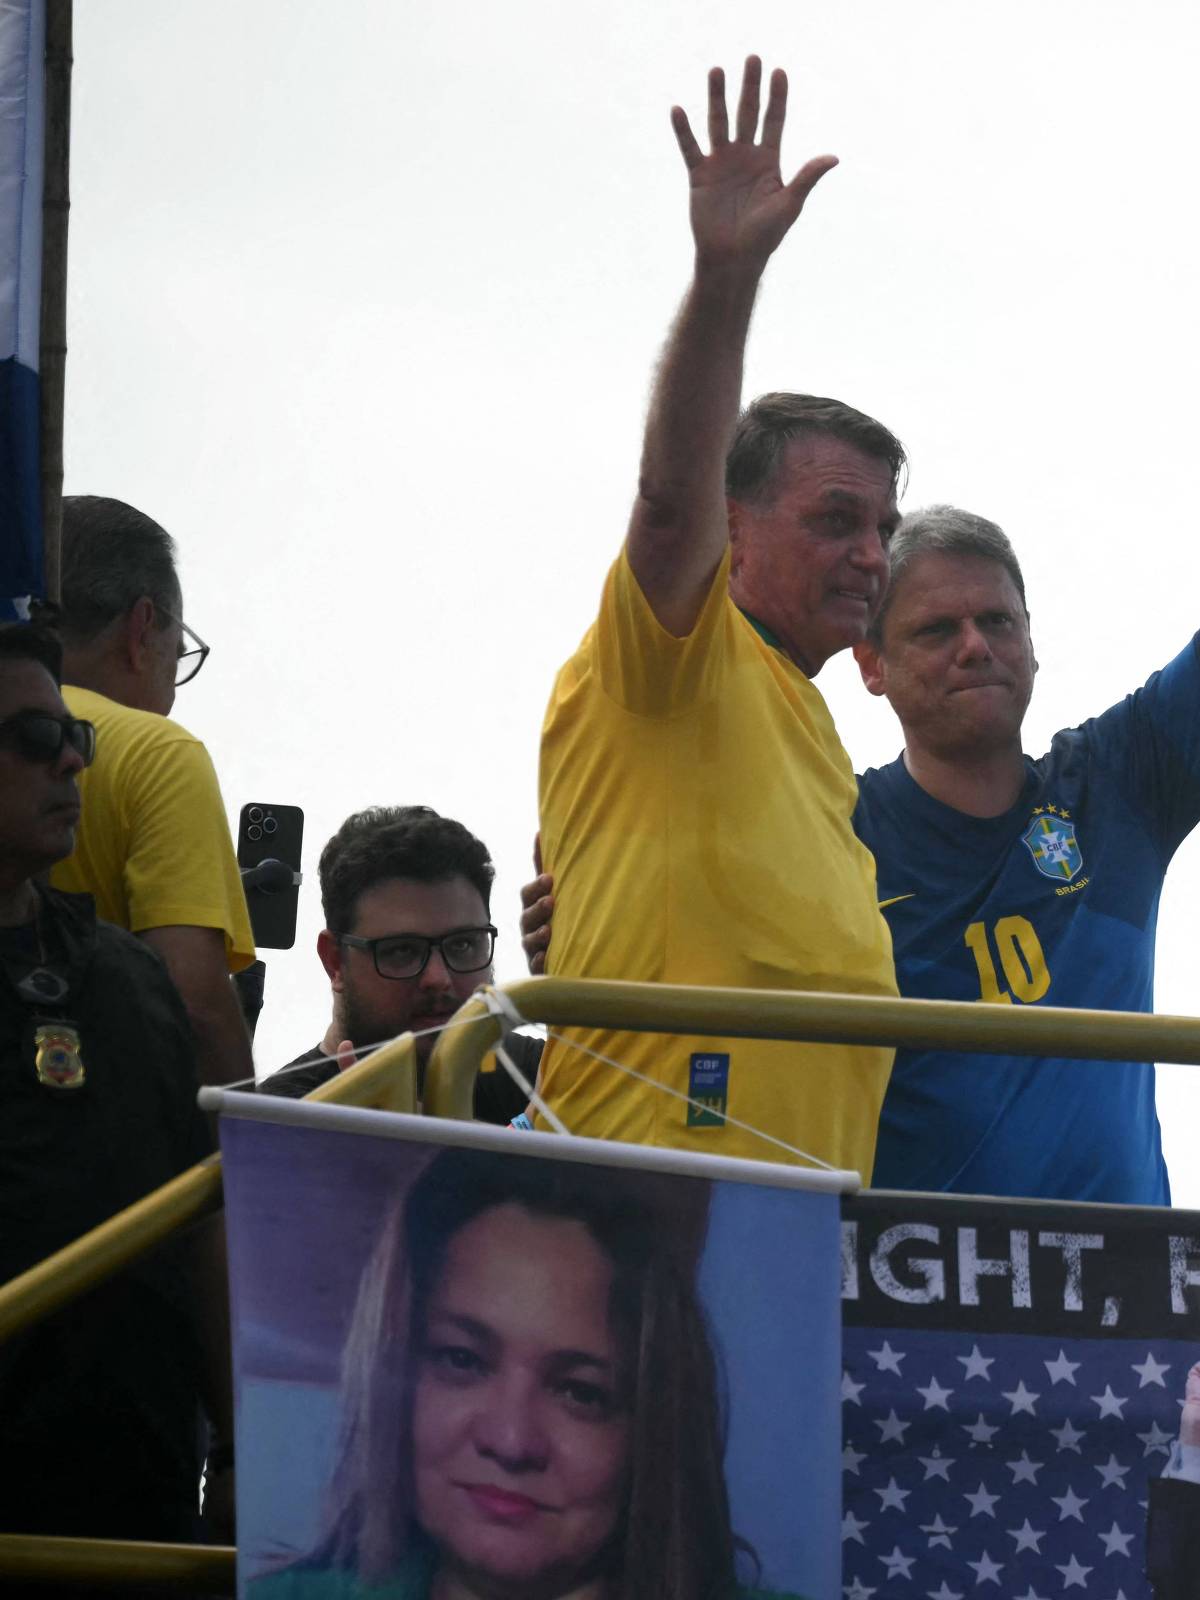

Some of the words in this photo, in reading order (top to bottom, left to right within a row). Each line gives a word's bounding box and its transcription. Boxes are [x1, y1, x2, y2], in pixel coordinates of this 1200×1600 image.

[1047, 841, 1064, 852] CBF
[1055, 877, 1089, 896] BRASIL
[964, 915, 1051, 1004] 10
[695, 1060, 720, 1070] CBF
[842, 1220, 1122, 1327] IGHT,
